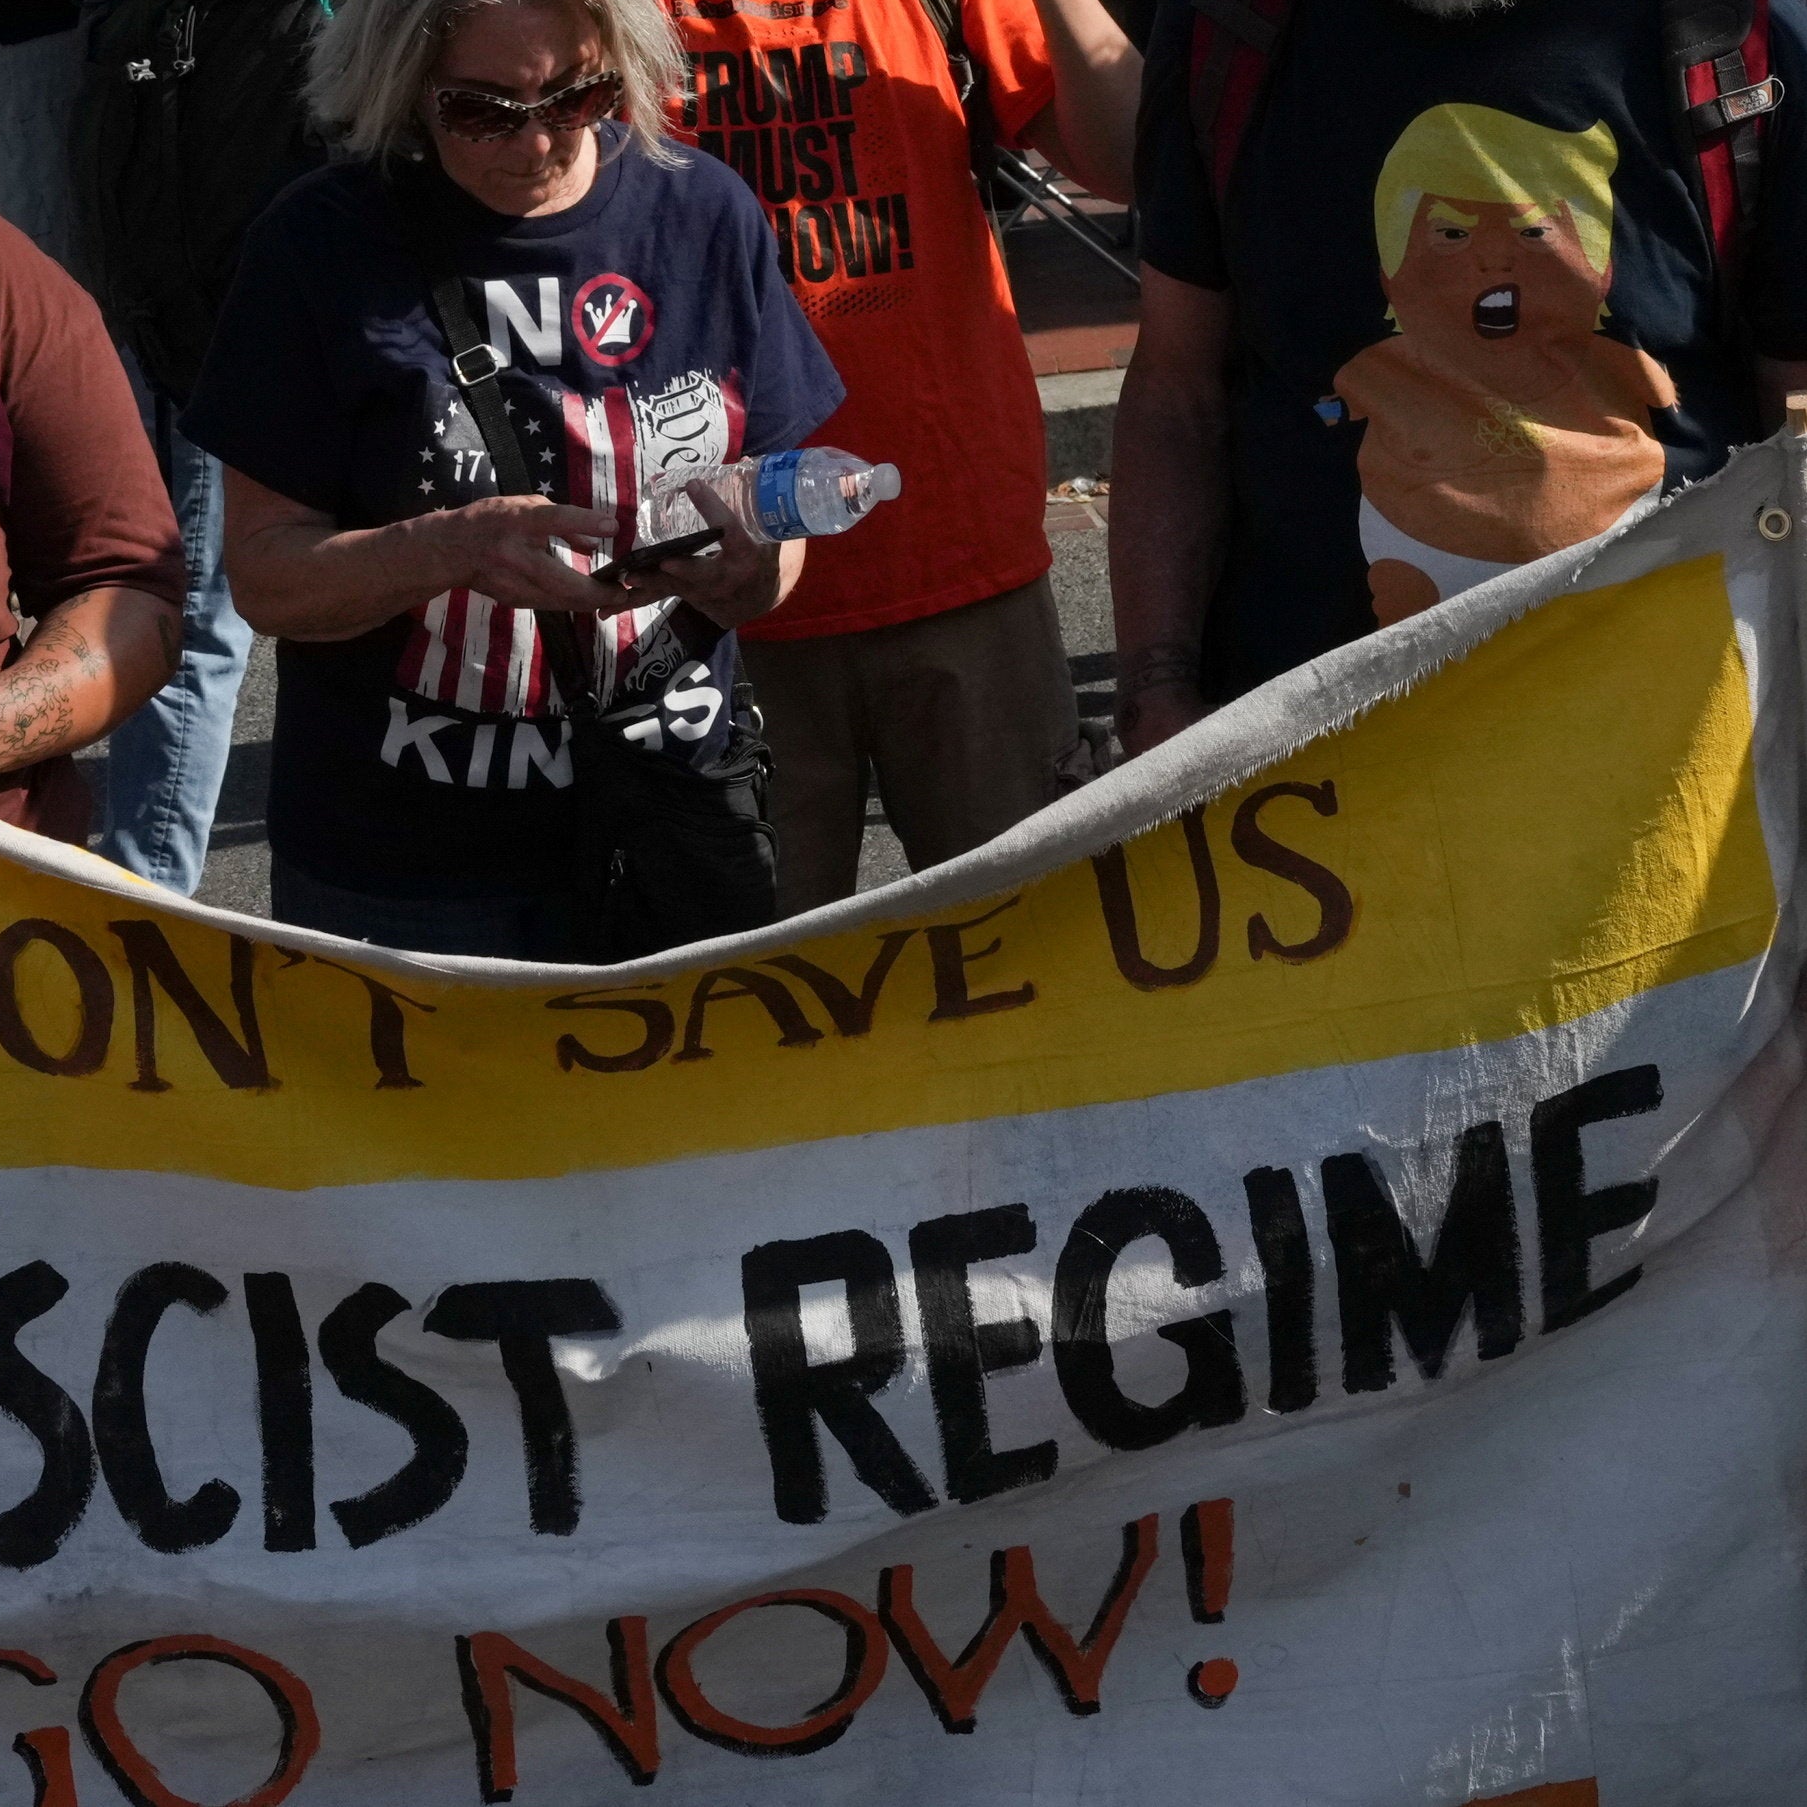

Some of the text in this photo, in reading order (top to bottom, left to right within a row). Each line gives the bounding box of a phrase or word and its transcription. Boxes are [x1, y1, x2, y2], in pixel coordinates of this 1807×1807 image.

[543, 895, 1040, 1075] SAVE
[1090, 780, 1358, 992] US
[739, 1062, 1667, 1527] REGIME
[454, 1496, 1239, 1804] NOW!
